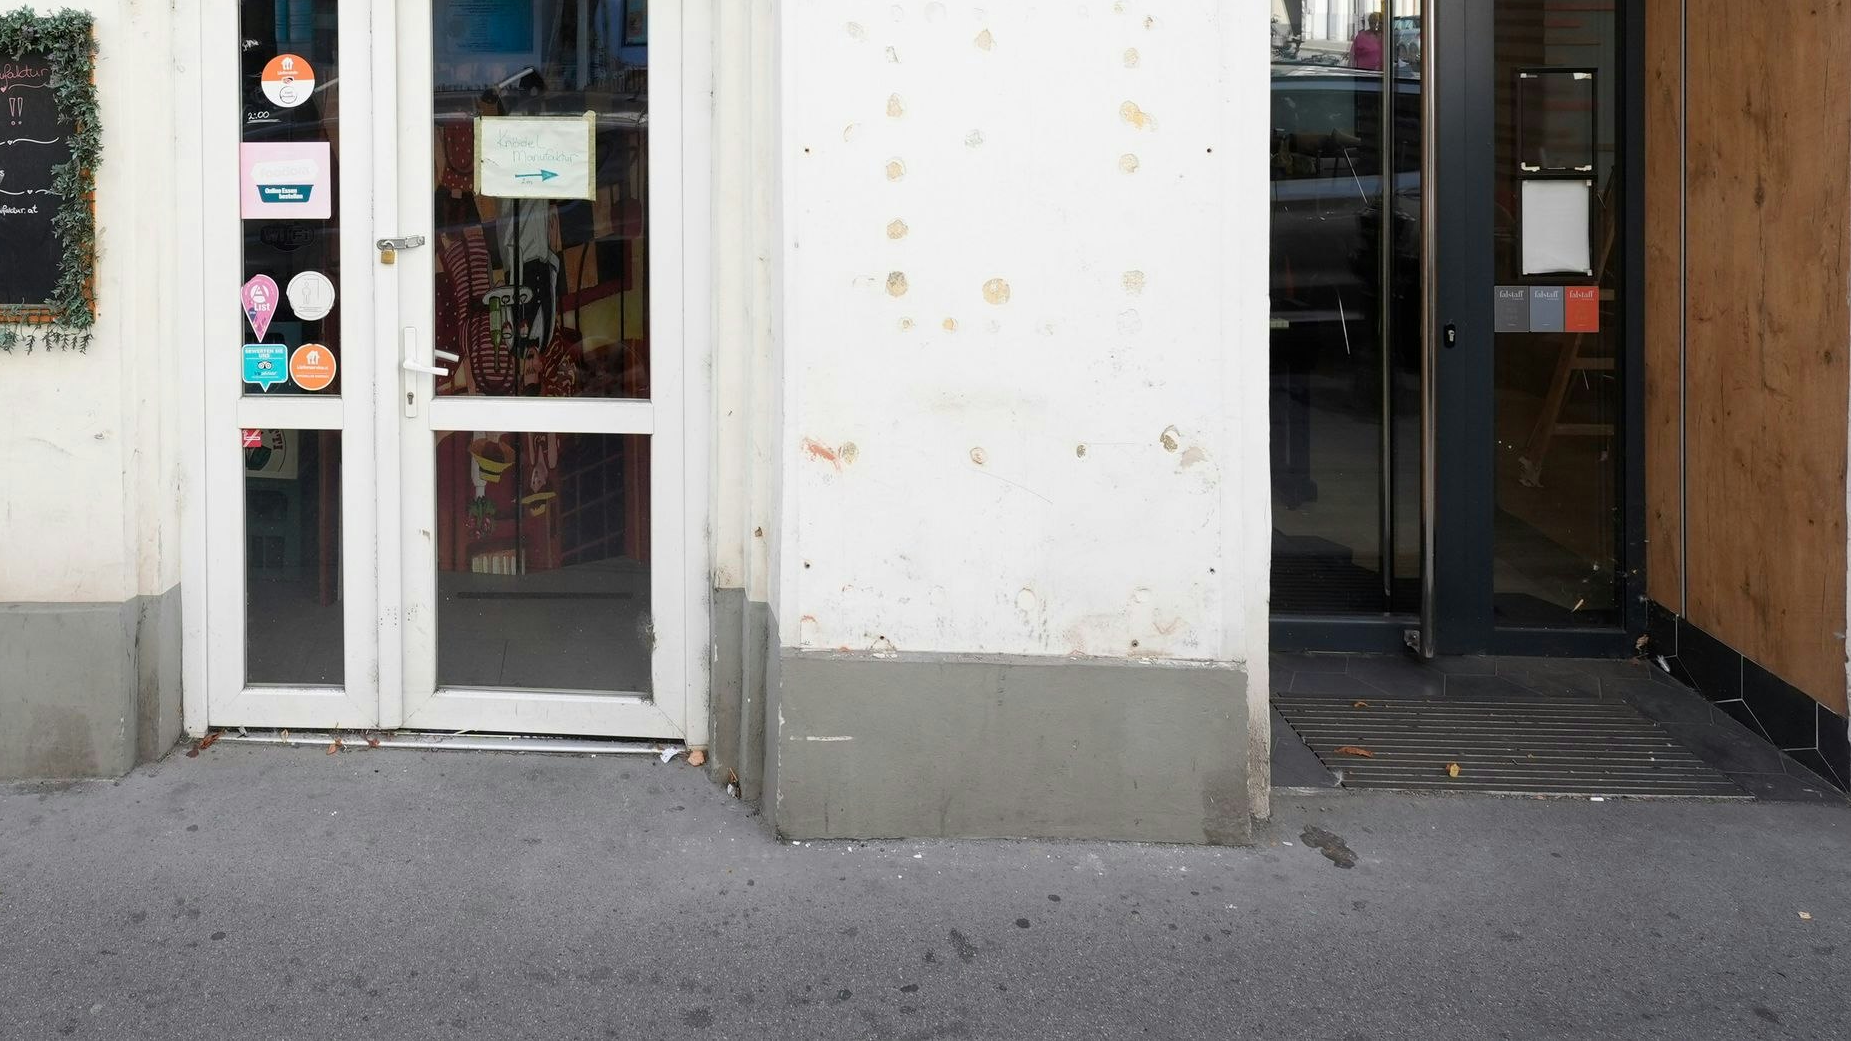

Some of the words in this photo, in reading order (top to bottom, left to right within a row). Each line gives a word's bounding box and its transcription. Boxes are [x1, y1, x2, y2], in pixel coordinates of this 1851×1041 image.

[1499, 290, 1524, 298] falstaff
[1534, 290, 1559, 298] falstaff
[1569, 290, 1594, 298] falstaff
